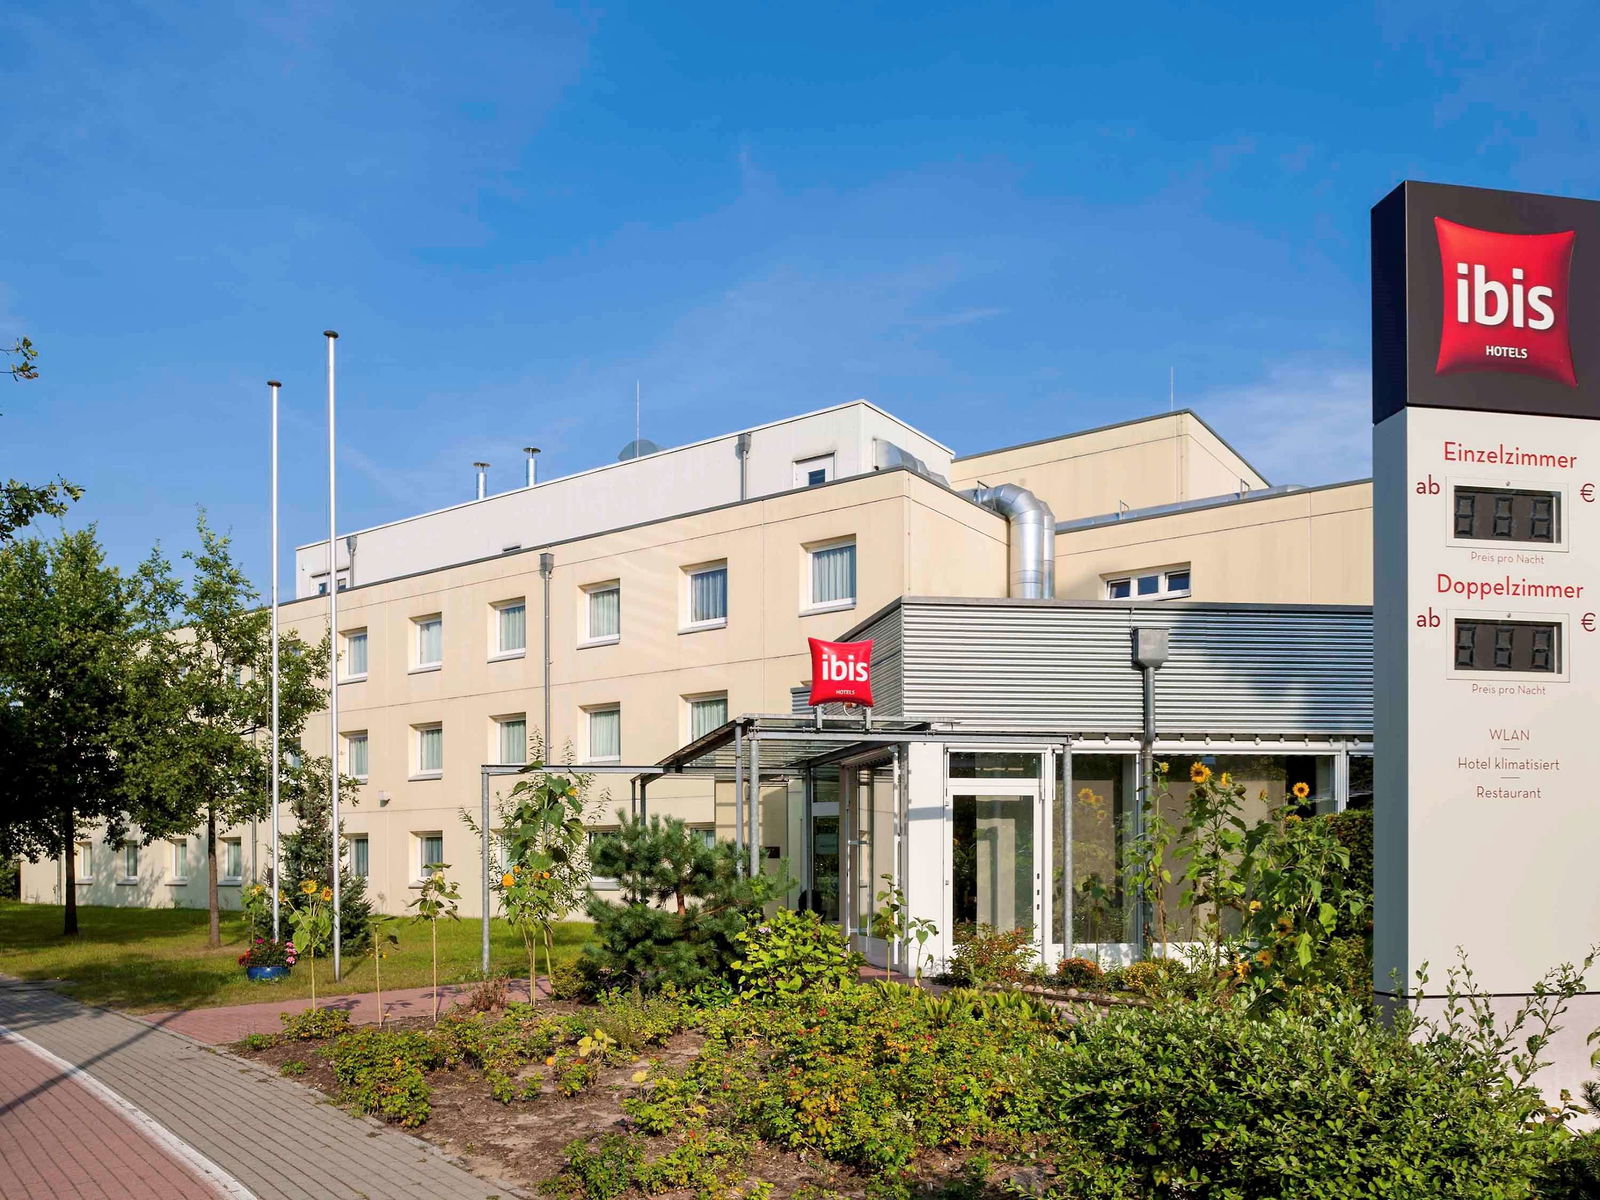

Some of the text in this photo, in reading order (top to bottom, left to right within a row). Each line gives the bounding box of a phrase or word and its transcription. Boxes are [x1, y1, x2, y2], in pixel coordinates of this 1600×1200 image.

[1457, 262, 1555, 330] ibis
[1485, 345, 1528, 359] HOTELS
[1444, 441, 1577, 469] Einzelzimmer
[1416, 474, 1441, 495] ab
[1580, 483, 1596, 503] €
[1471, 551, 1545, 565] Preis pro Nacht
[1437, 573, 1584, 600] Doppelzimmer
[1416, 607, 1441, 628] ab
[1581, 612, 1596, 632] €
[822, 653, 869, 682] ibis
[1472, 683, 1546, 696] Preis pro Nacht
[1489, 728, 1530, 741] WLAN
[1458, 757, 1560, 771] Hotel klimatisiert
[1476, 785, 1542, 799] Restaurant
